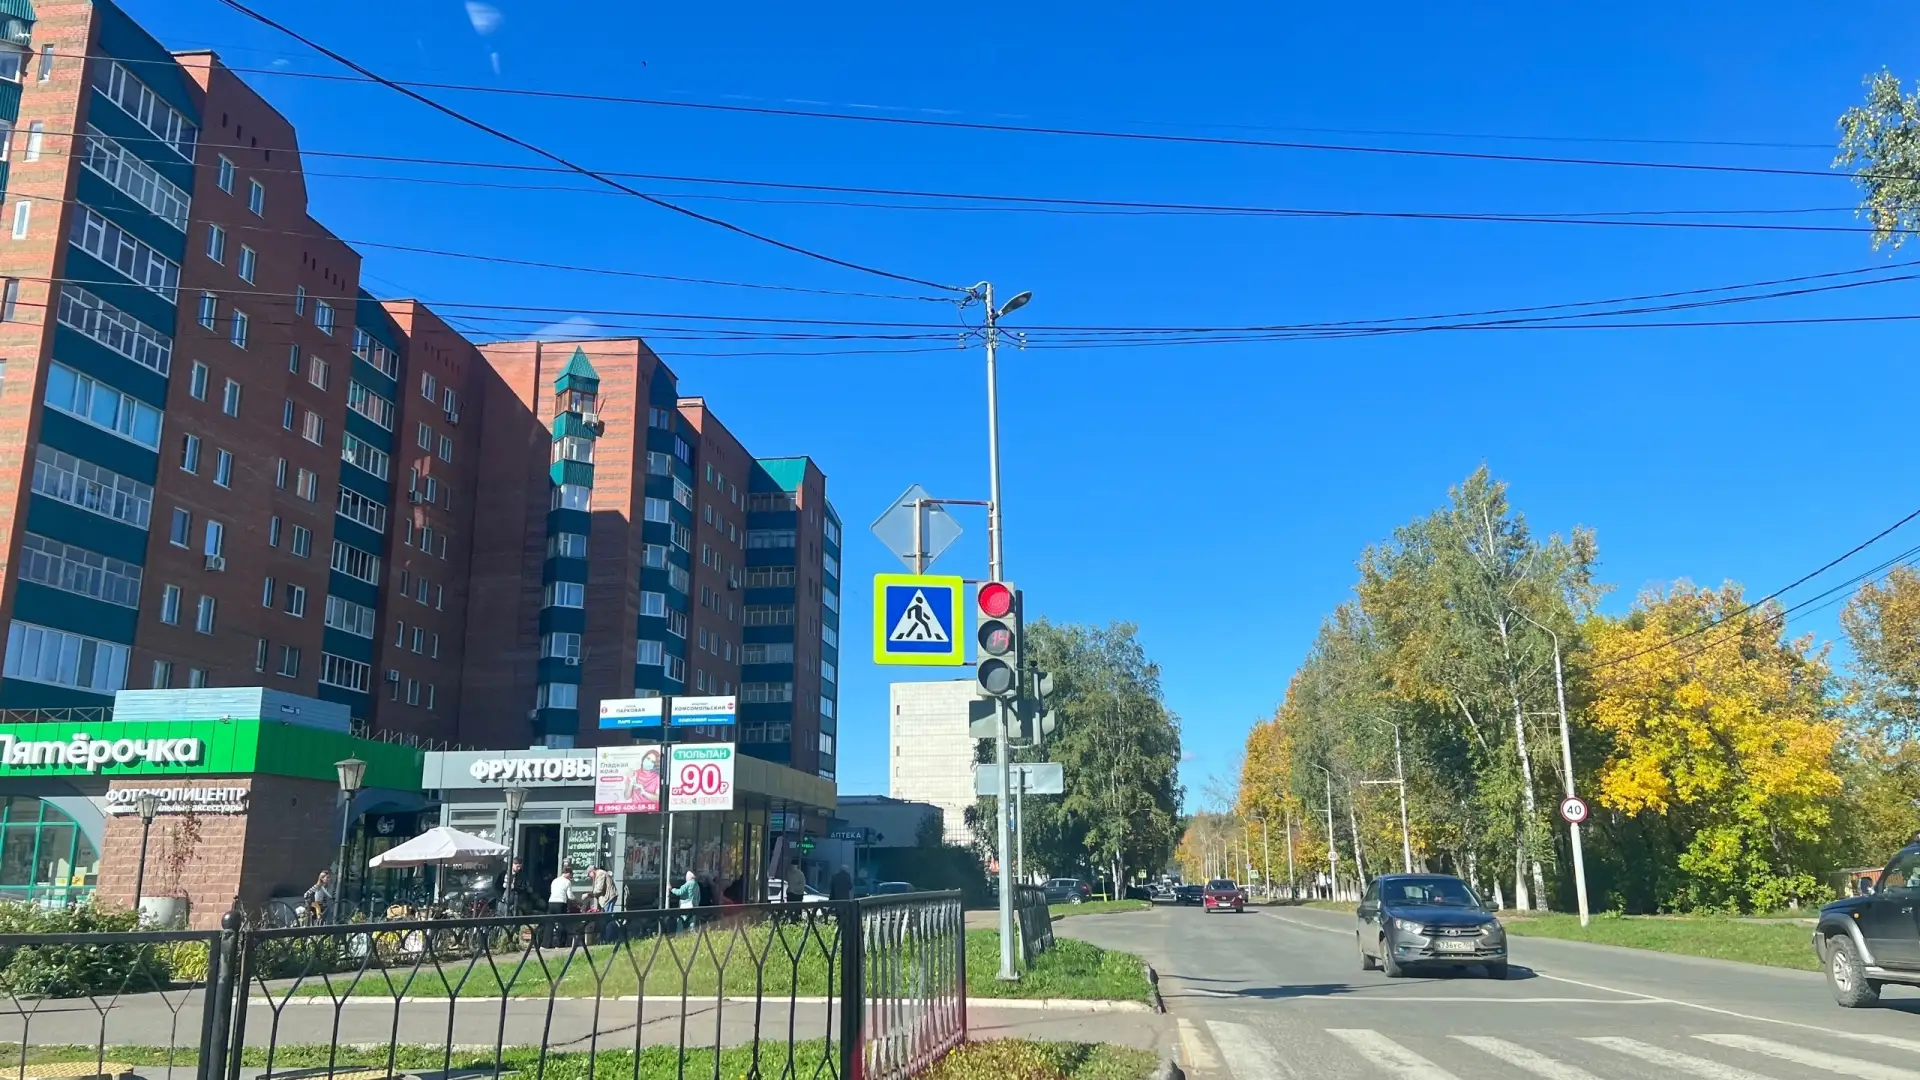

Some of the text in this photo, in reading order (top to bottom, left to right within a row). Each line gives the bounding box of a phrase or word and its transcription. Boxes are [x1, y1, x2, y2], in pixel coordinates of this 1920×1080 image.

[993, 630, 1011, 649] 14
[0, 733, 200, 771] Пятёрочка
[677, 750, 727, 759] ТЮЛЬПАН
[1567, 805, 1581, 815] 40
